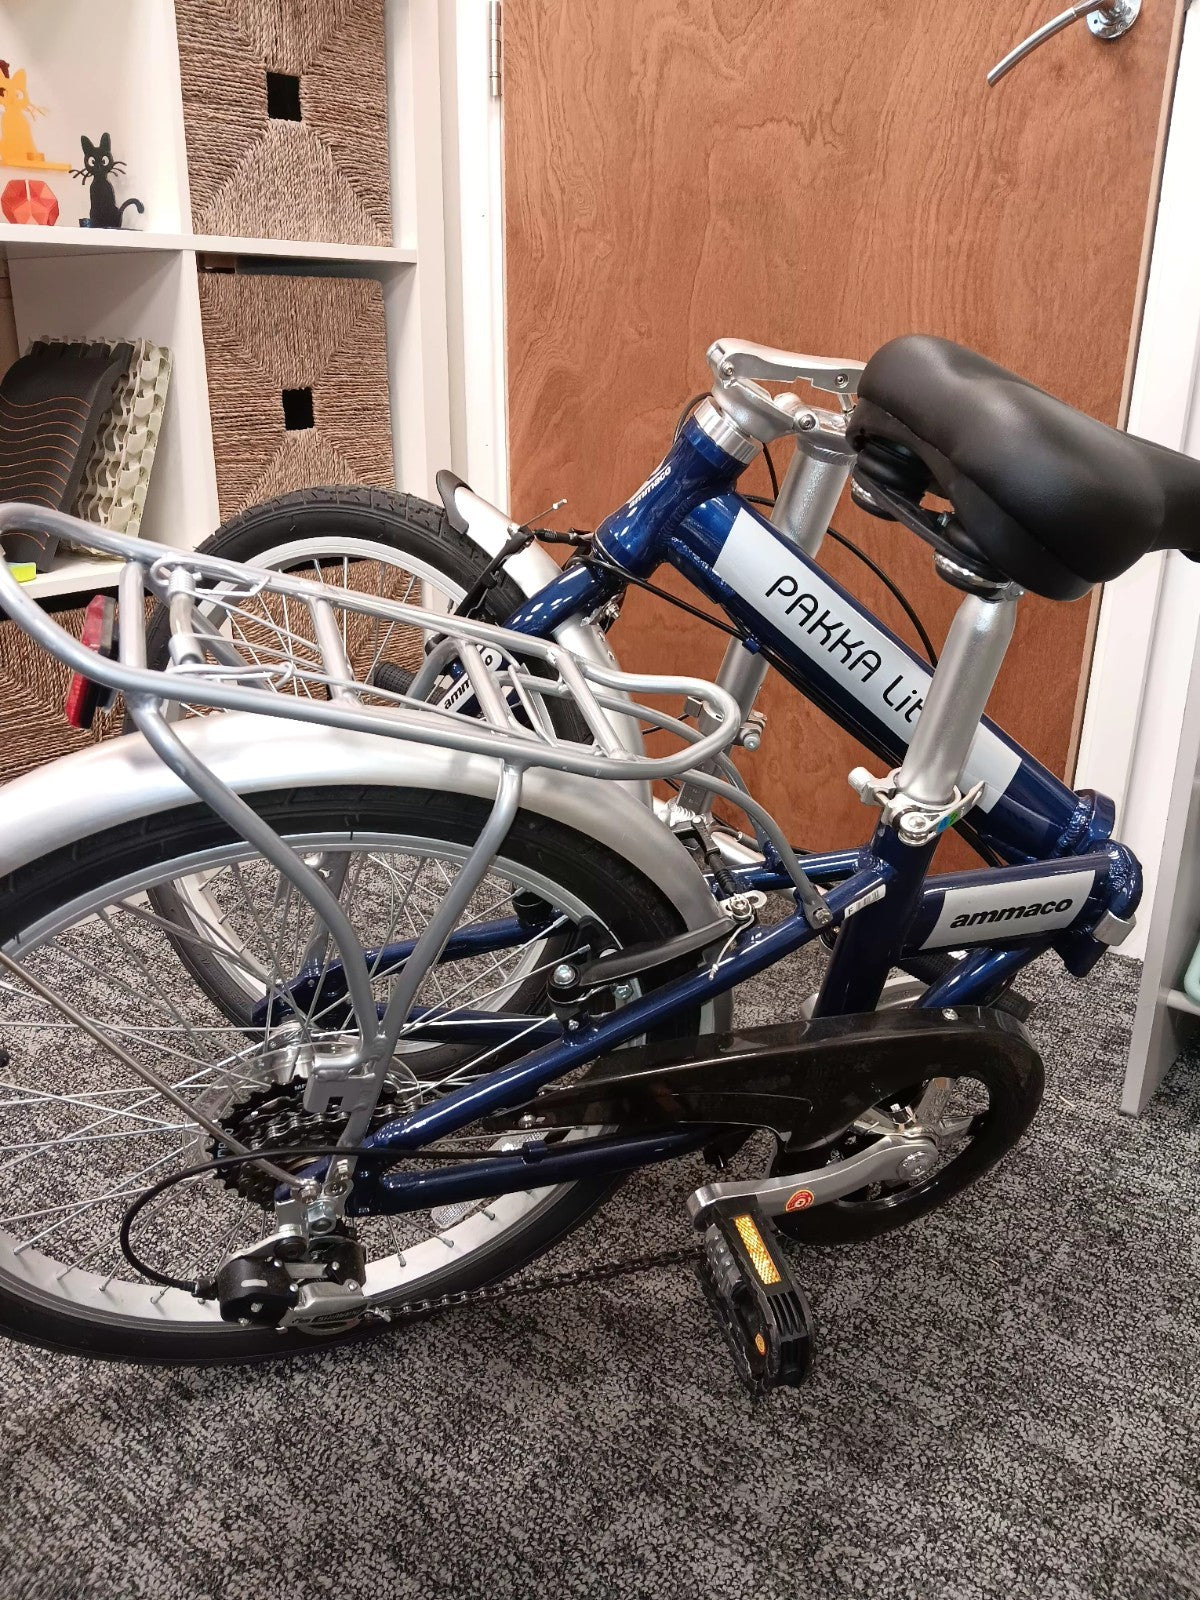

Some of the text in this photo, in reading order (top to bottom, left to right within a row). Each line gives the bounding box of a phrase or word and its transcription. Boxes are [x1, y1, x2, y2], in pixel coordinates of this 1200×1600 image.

[765, 575, 924, 723] PAKKA Lit
[443, 654, 493, 710] ammo
[949, 898, 1073, 929] ammaco
